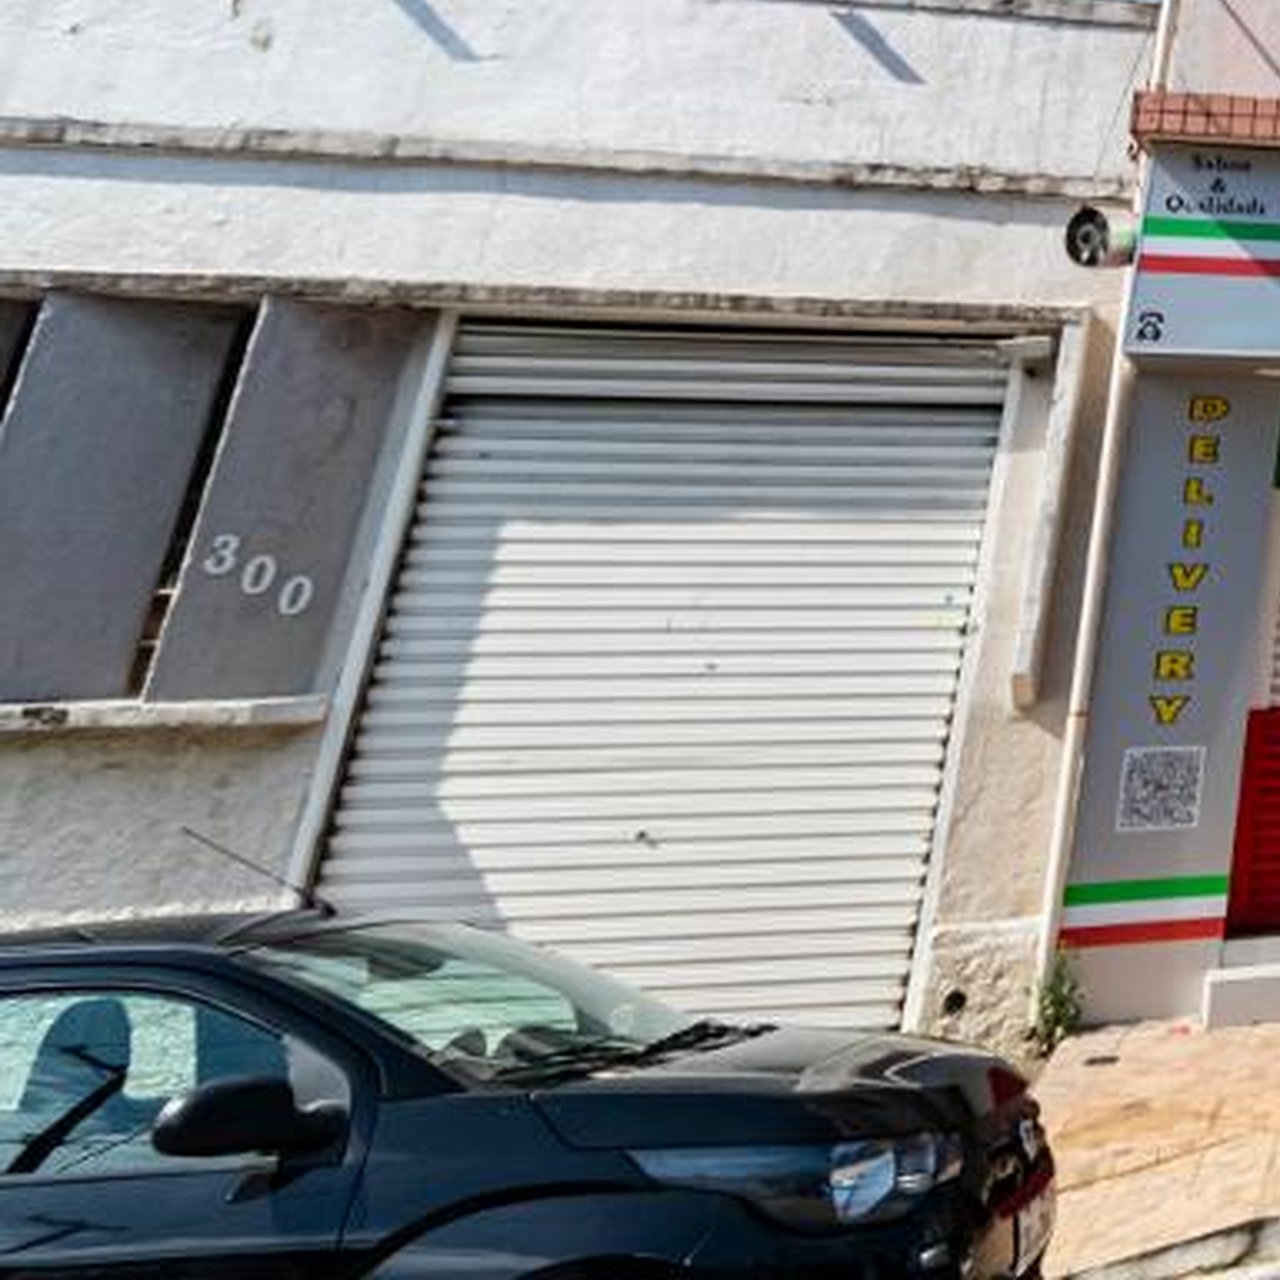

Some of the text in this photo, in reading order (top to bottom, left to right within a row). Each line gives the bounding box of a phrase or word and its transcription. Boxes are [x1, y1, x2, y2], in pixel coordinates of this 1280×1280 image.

[1211, 178, 1226, 194] &
[203, 532, 313, 616] 300
[1149, 394, 1231, 727] DELIVERY
